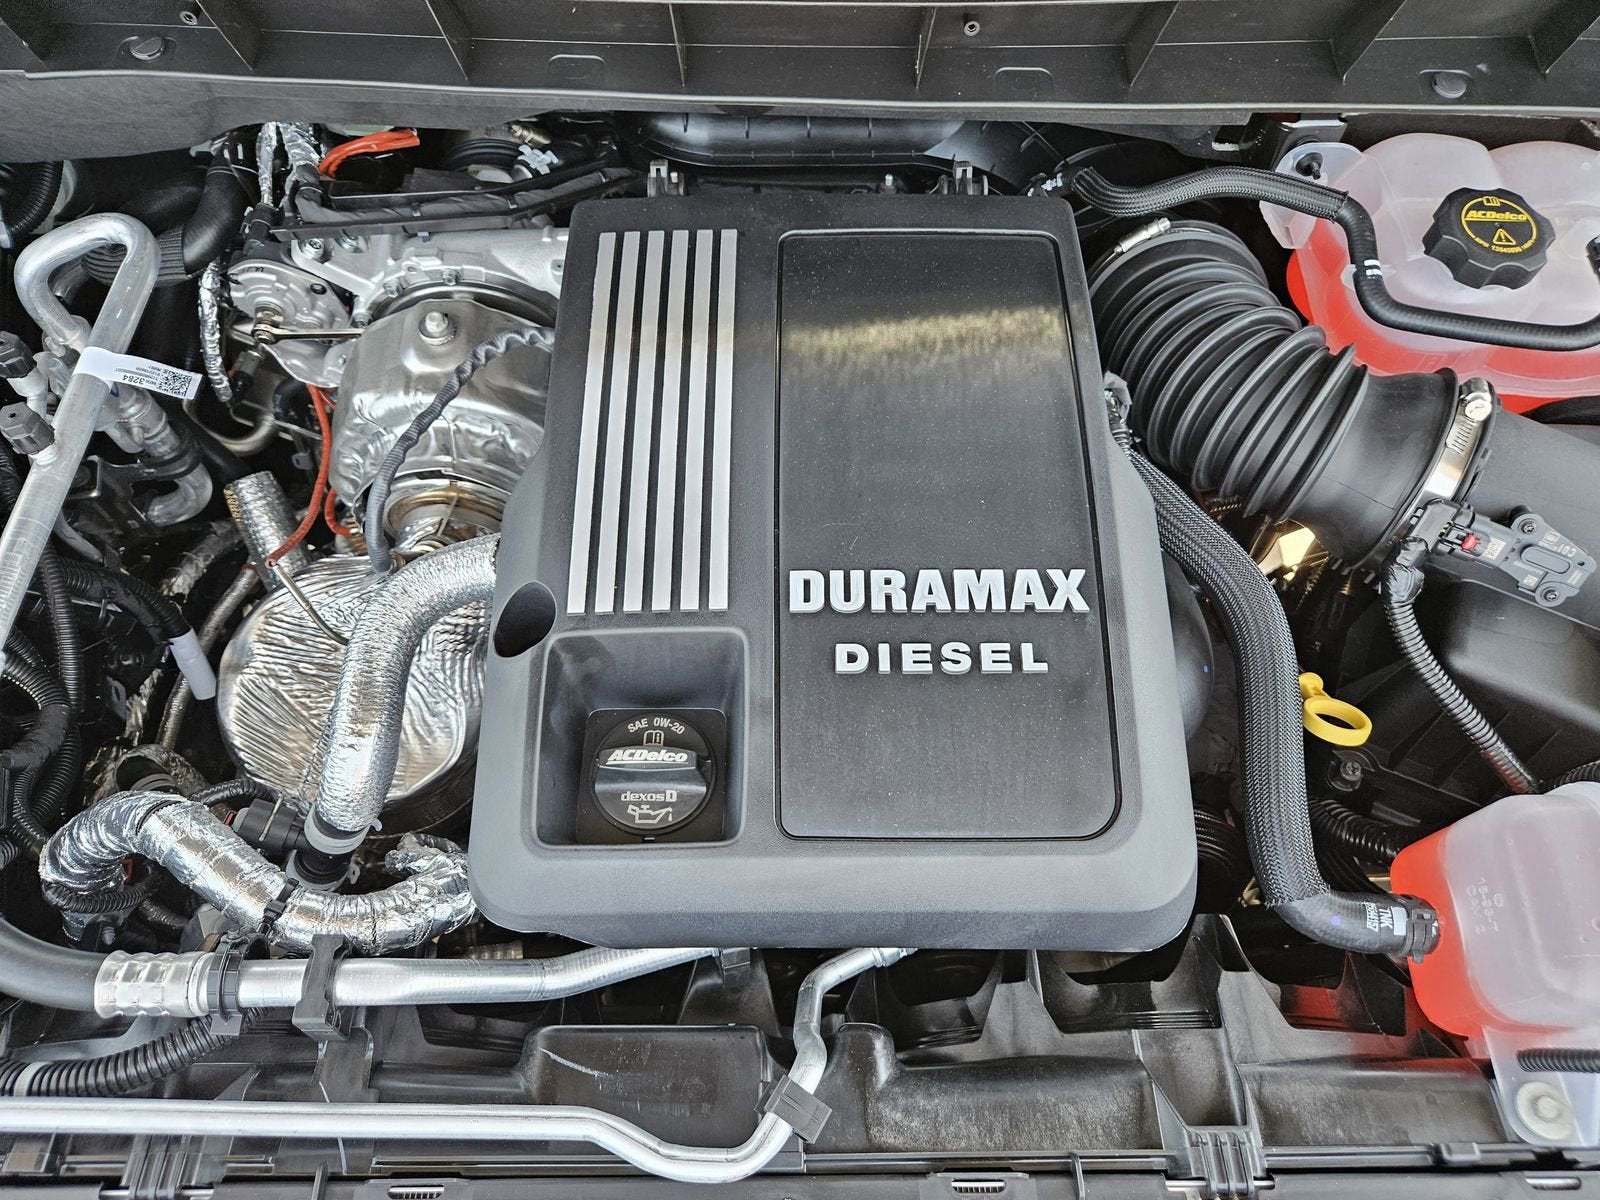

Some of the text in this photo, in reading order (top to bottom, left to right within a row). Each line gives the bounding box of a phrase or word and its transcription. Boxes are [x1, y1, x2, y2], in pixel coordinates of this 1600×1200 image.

[1465, 210, 1527, 221] ACDelco
[122, 374, 146, 385] 3284
[789, 568, 1090, 613] DURAMAX
[835, 642, 1049, 675] DIESEL
[627, 718, 649, 733] SAE
[607, 749, 688, 763] ACDelco
[621, 789, 678, 803] dexosD
[1379, 905, 1393, 929] TNK
